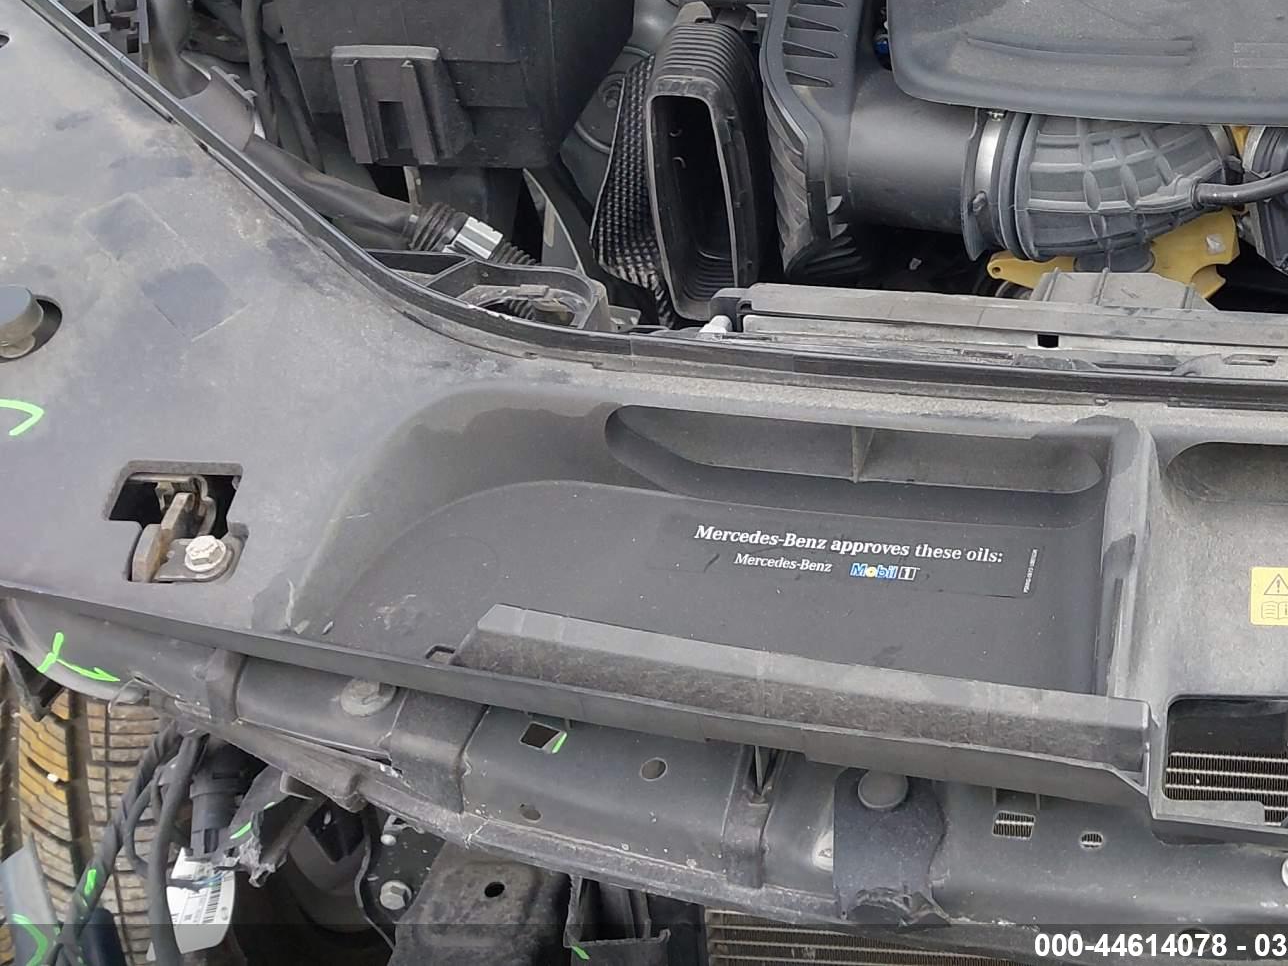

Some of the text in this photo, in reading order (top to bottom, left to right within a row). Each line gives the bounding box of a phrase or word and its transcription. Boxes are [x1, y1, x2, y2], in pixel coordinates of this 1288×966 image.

[694, 524, 1004, 564] Mercedes-Benz approves these oils:
[733, 552, 833, 573] Mercedes-Benz
[850, 562, 898, 579] Mobil
